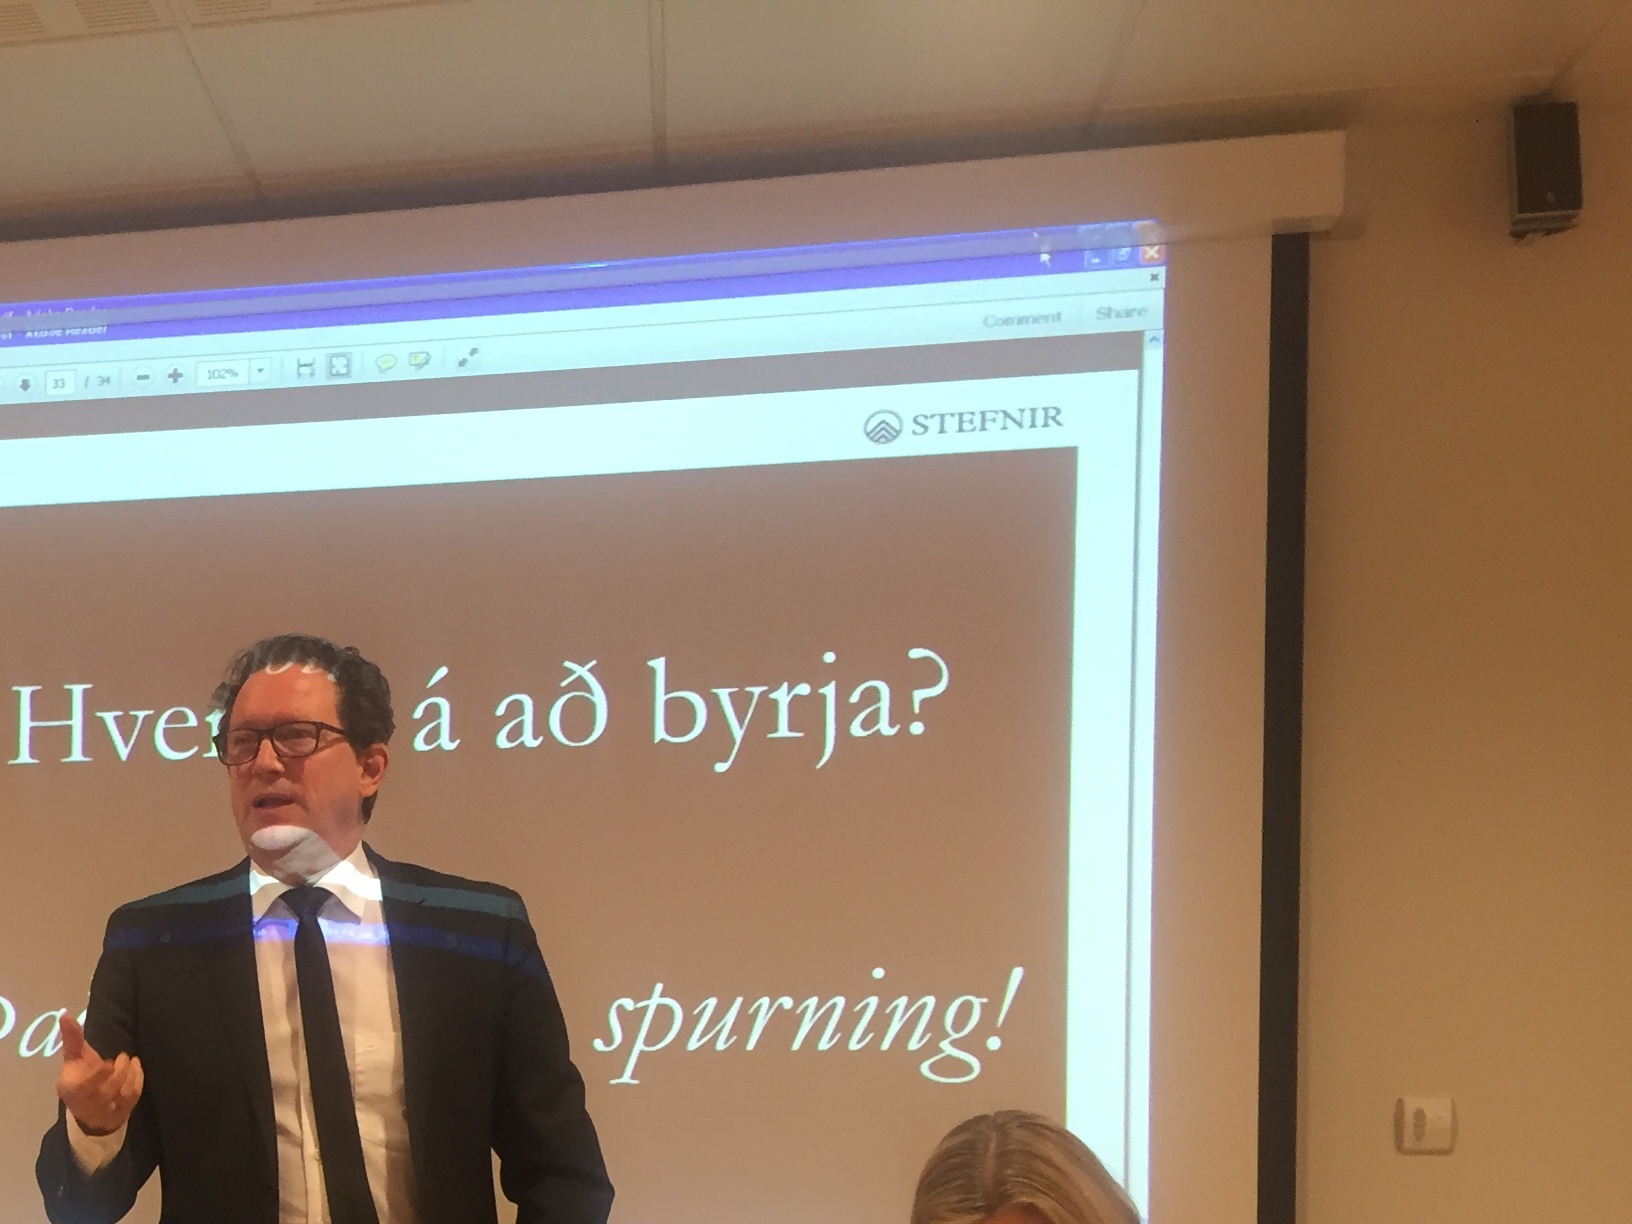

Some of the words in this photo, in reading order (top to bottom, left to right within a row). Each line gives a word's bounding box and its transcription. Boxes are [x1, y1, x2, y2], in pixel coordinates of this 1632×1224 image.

[982, 311, 1063, 328] Comment
[1095, 305, 1148, 321] Share
[911, 405, 1065, 437] STEFNIR
[412, 666, 460, 752] á
[494, 660, 608, 749] að
[646, 647, 950, 772] byrja?
[592, 966, 1024, 1084] spurning!
